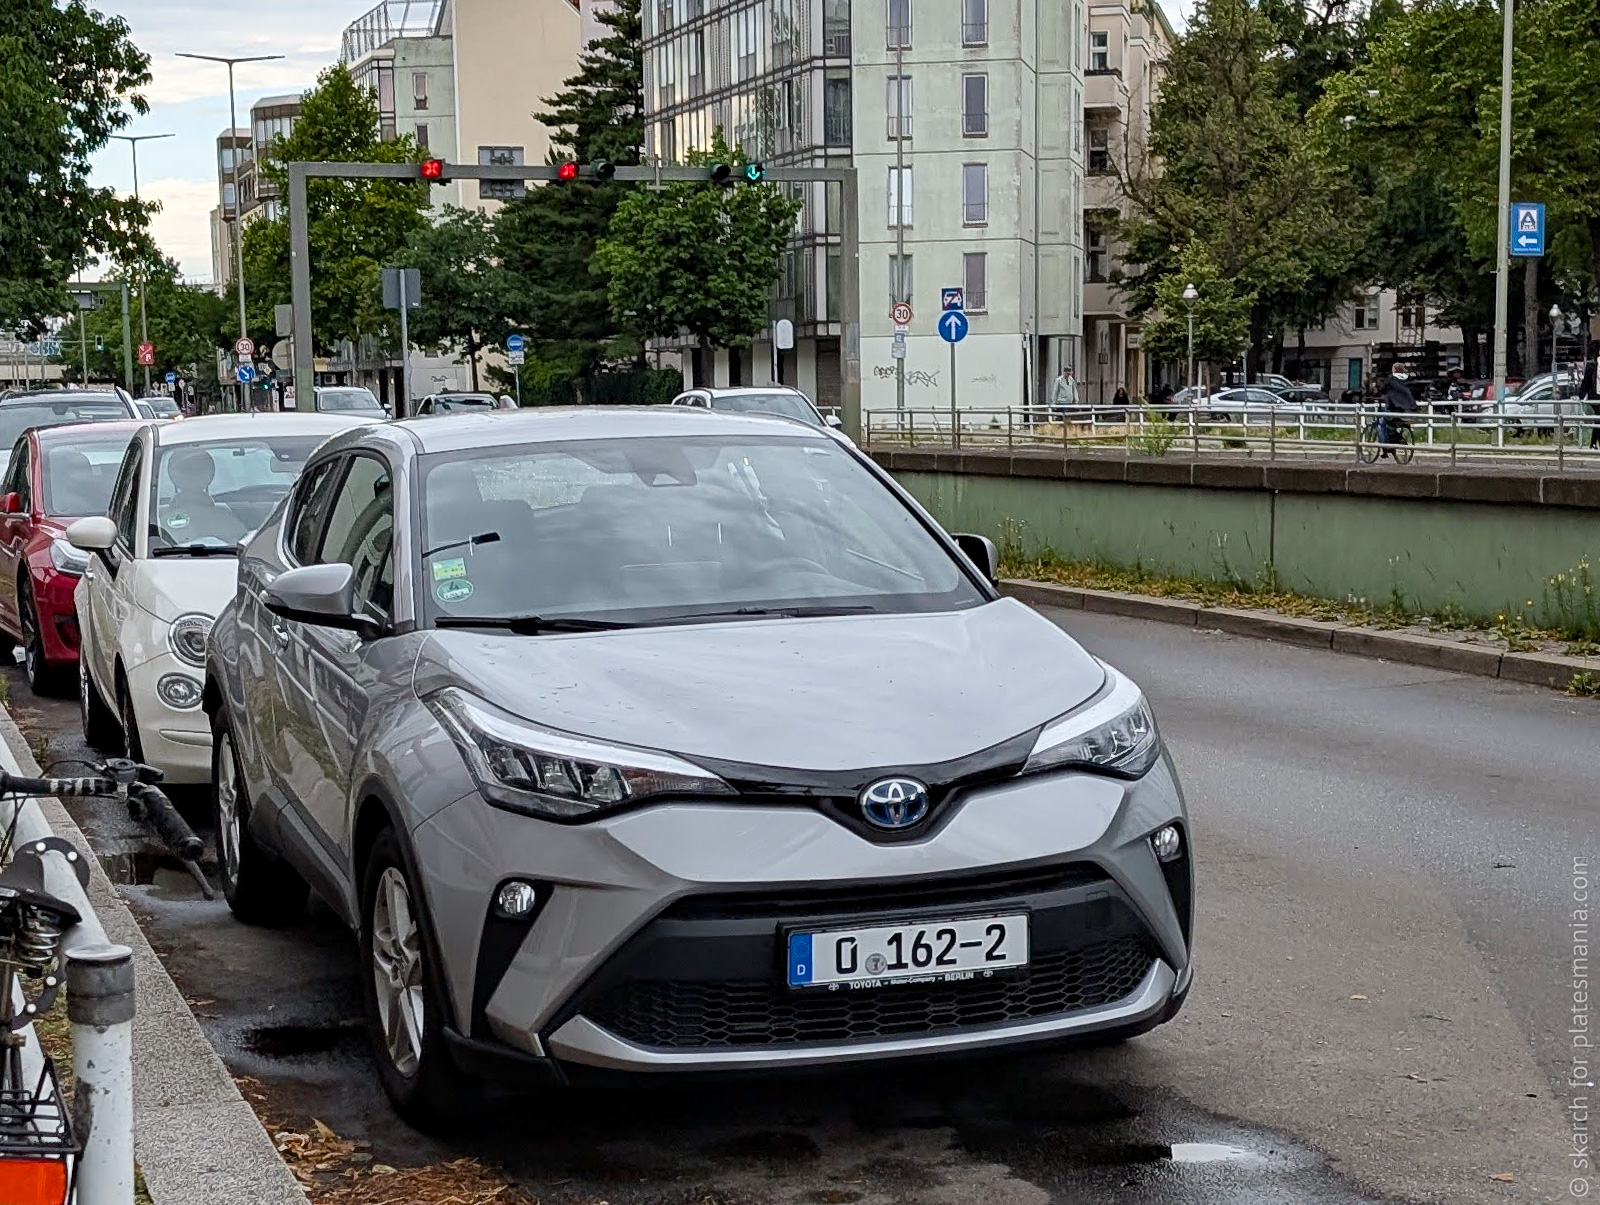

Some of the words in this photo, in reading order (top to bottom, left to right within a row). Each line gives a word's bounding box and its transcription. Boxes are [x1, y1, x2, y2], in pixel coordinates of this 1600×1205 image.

[896, 308, 909, 320] 30
[240, 342, 250, 351] 30
[887, 923, 1007, 971] 162-2
[796, 964, 806, 976] D
[849, 979, 881, 989] TOYOTA
